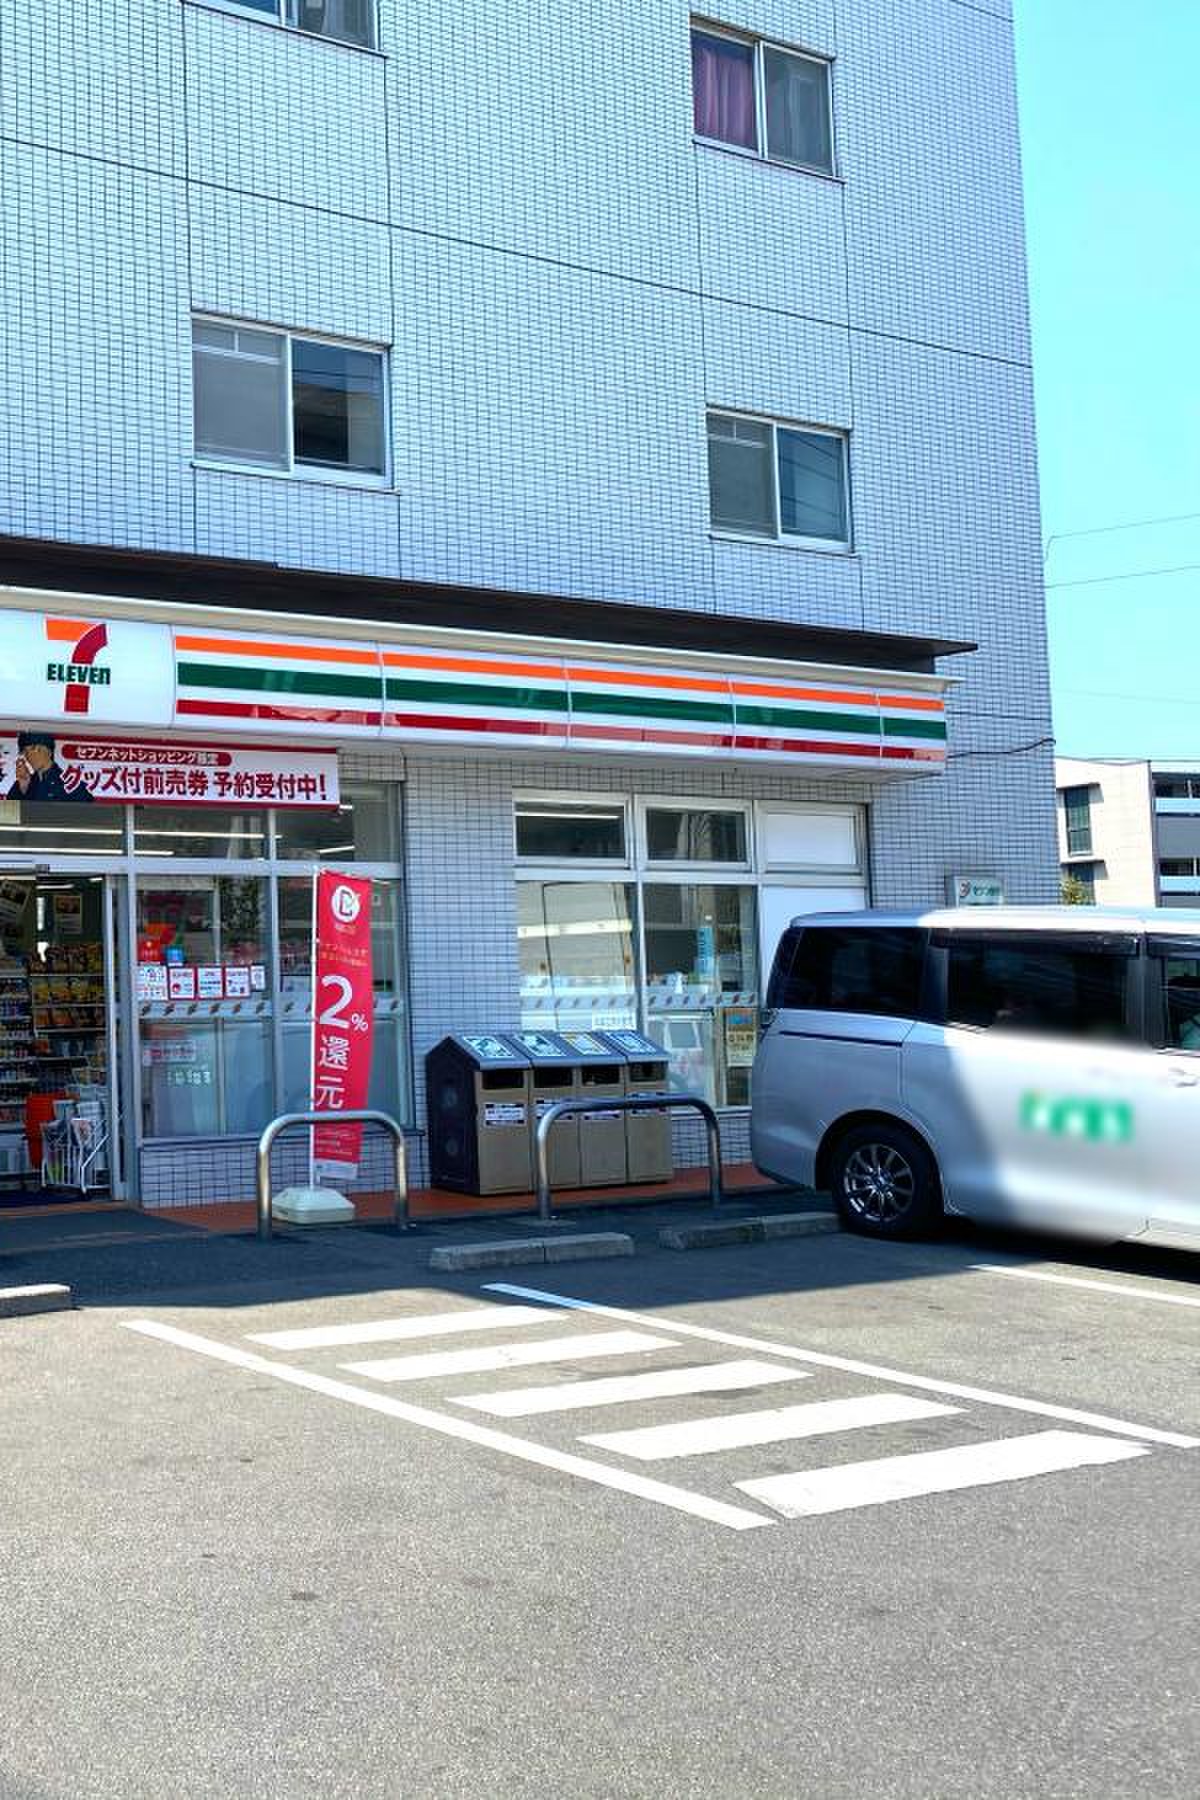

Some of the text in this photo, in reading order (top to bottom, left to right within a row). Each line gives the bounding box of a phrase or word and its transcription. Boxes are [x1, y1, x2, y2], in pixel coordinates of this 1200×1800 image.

[61, 765, 327, 800] グッズ付前売券 予約受付中!
